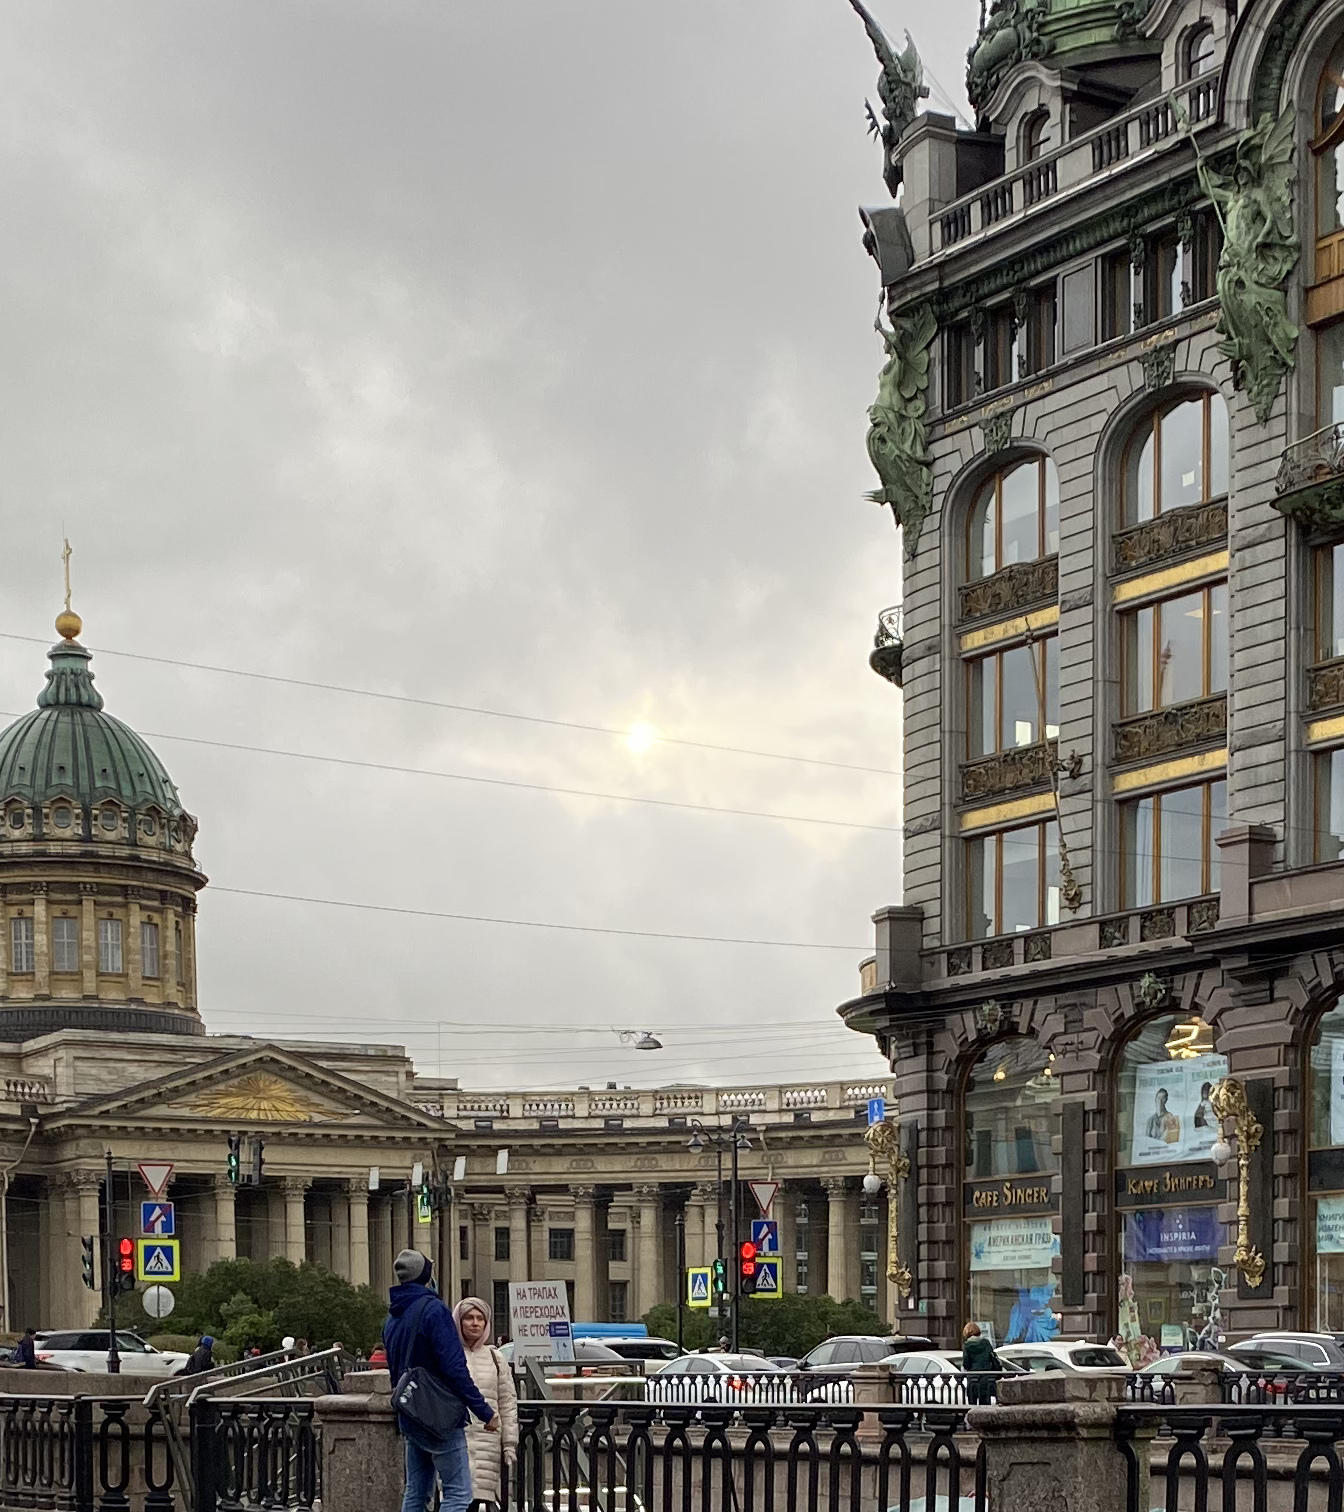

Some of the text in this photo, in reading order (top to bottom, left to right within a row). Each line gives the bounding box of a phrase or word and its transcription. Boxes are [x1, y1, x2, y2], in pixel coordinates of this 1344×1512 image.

[973, 1181, 1049, 1208] CAFE SINGER
[1160, 1231, 1197, 1242] INSPIRIA
[516, 1286, 558, 1301] НА ТРАПАХ
[513, 1304, 566, 1320] И ПЕРЕХОДАХ
[518, 1324, 528, 1337] НЕ
